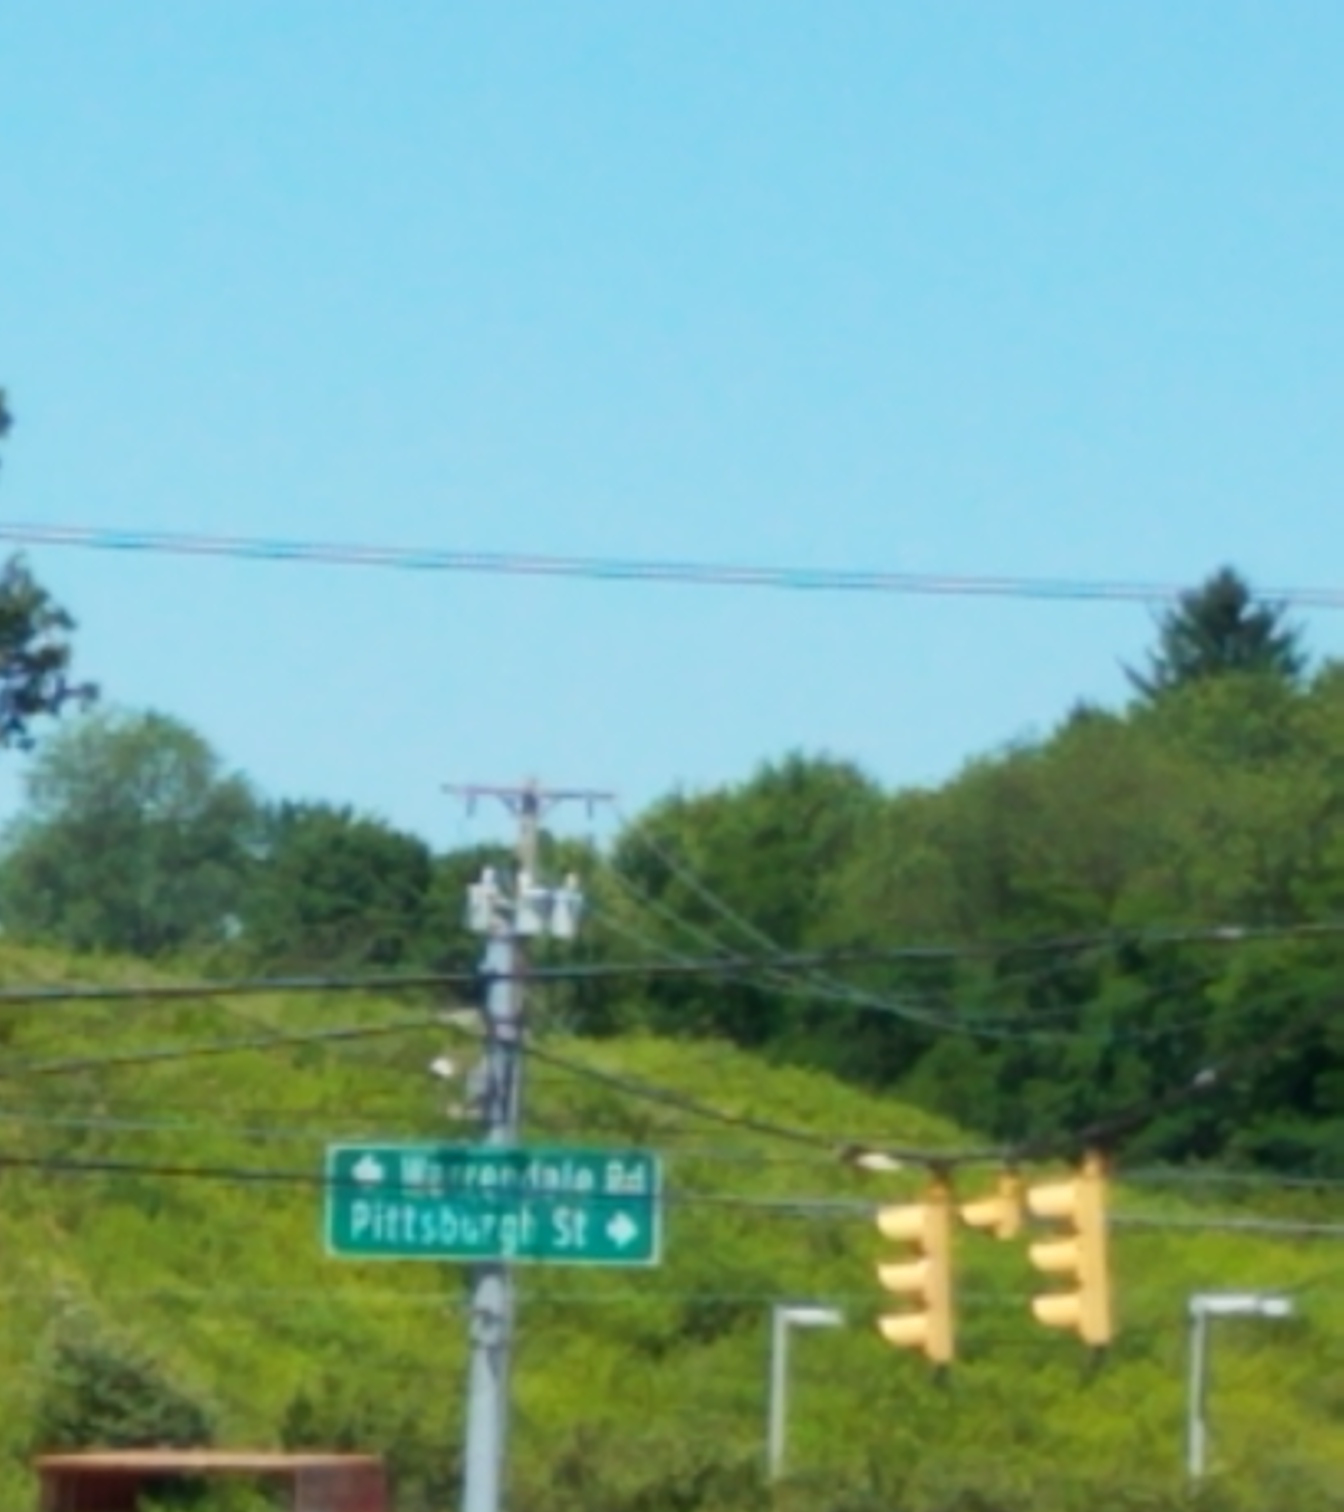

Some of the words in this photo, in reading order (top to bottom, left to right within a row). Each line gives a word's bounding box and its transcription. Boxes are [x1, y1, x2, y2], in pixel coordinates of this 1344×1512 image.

[605, 1161, 648, 1197] Rd
[350, 1202, 537, 1255] Pittsburgh
[551, 1206, 592, 1248] St
